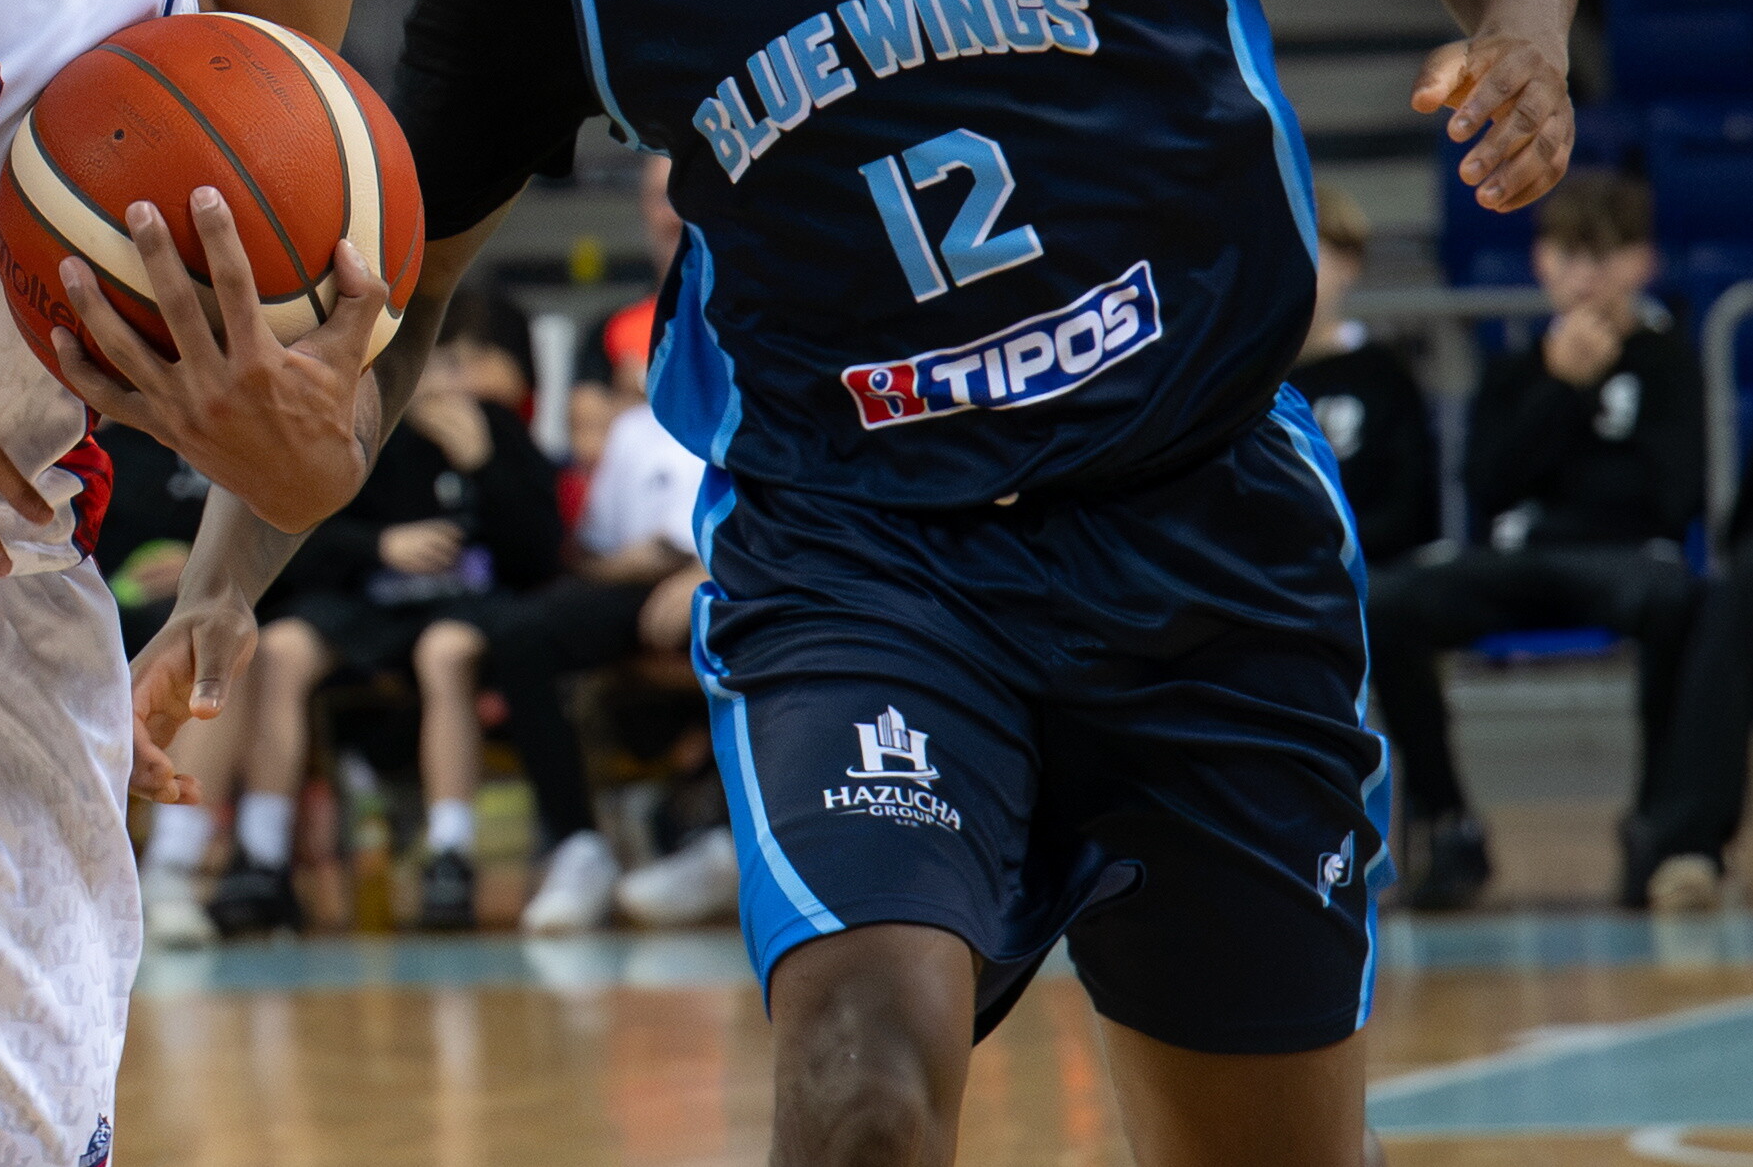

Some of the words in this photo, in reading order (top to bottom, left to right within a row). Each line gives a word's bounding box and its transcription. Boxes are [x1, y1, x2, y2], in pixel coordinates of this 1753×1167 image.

[692, 12, 857, 184] BLUE
[857, 127, 1045, 304] 12
[931, 284, 1140, 405] TIPOS
[822, 785, 962, 831] HAZUCHA
[868, 804, 936, 824] GROUP
